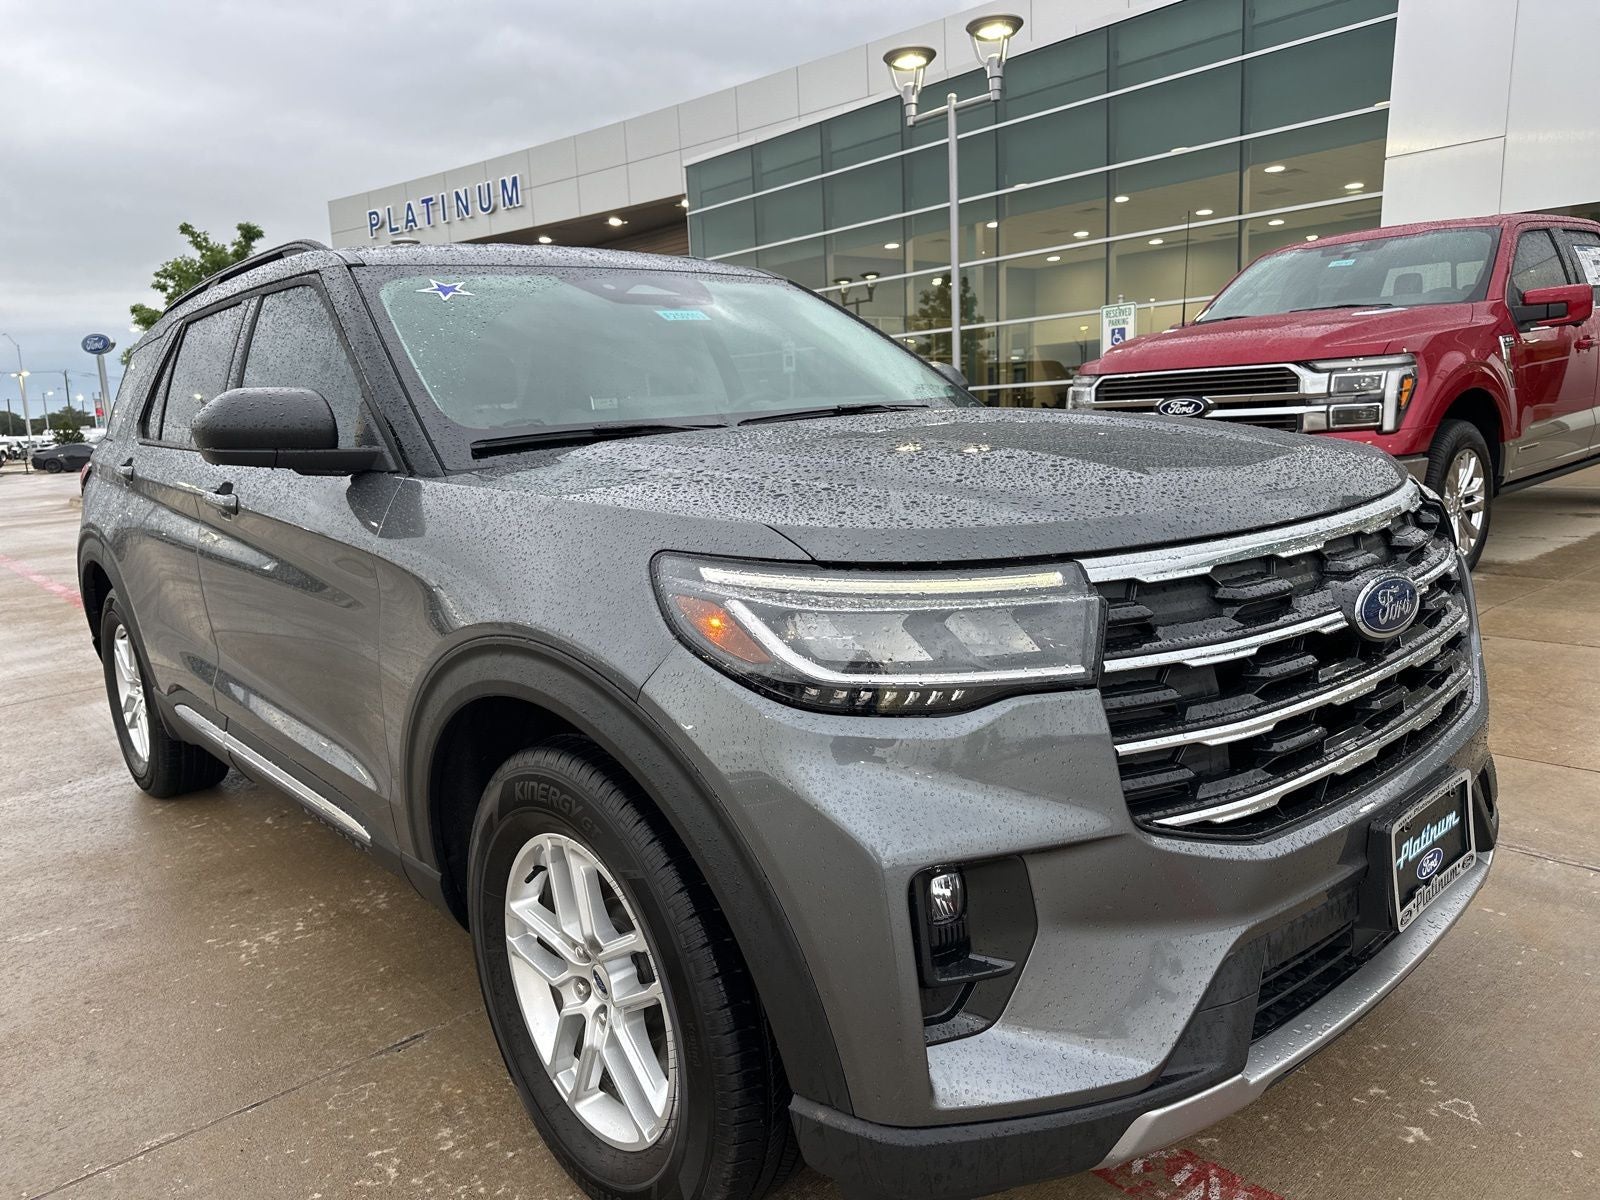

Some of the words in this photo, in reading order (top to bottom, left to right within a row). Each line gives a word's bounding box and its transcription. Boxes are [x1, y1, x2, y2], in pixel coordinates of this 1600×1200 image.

[367, 174, 521, 239] PLATINUM
[1105, 307, 1132, 318] RESERVED
[1108, 318, 1129, 327] PARKING
[1167, 401, 1196, 414] Ford
[1378, 585, 1412, 625] Ford
[1396, 810, 1461, 870] Platinum
[1421, 852, 1439, 877] Ford
